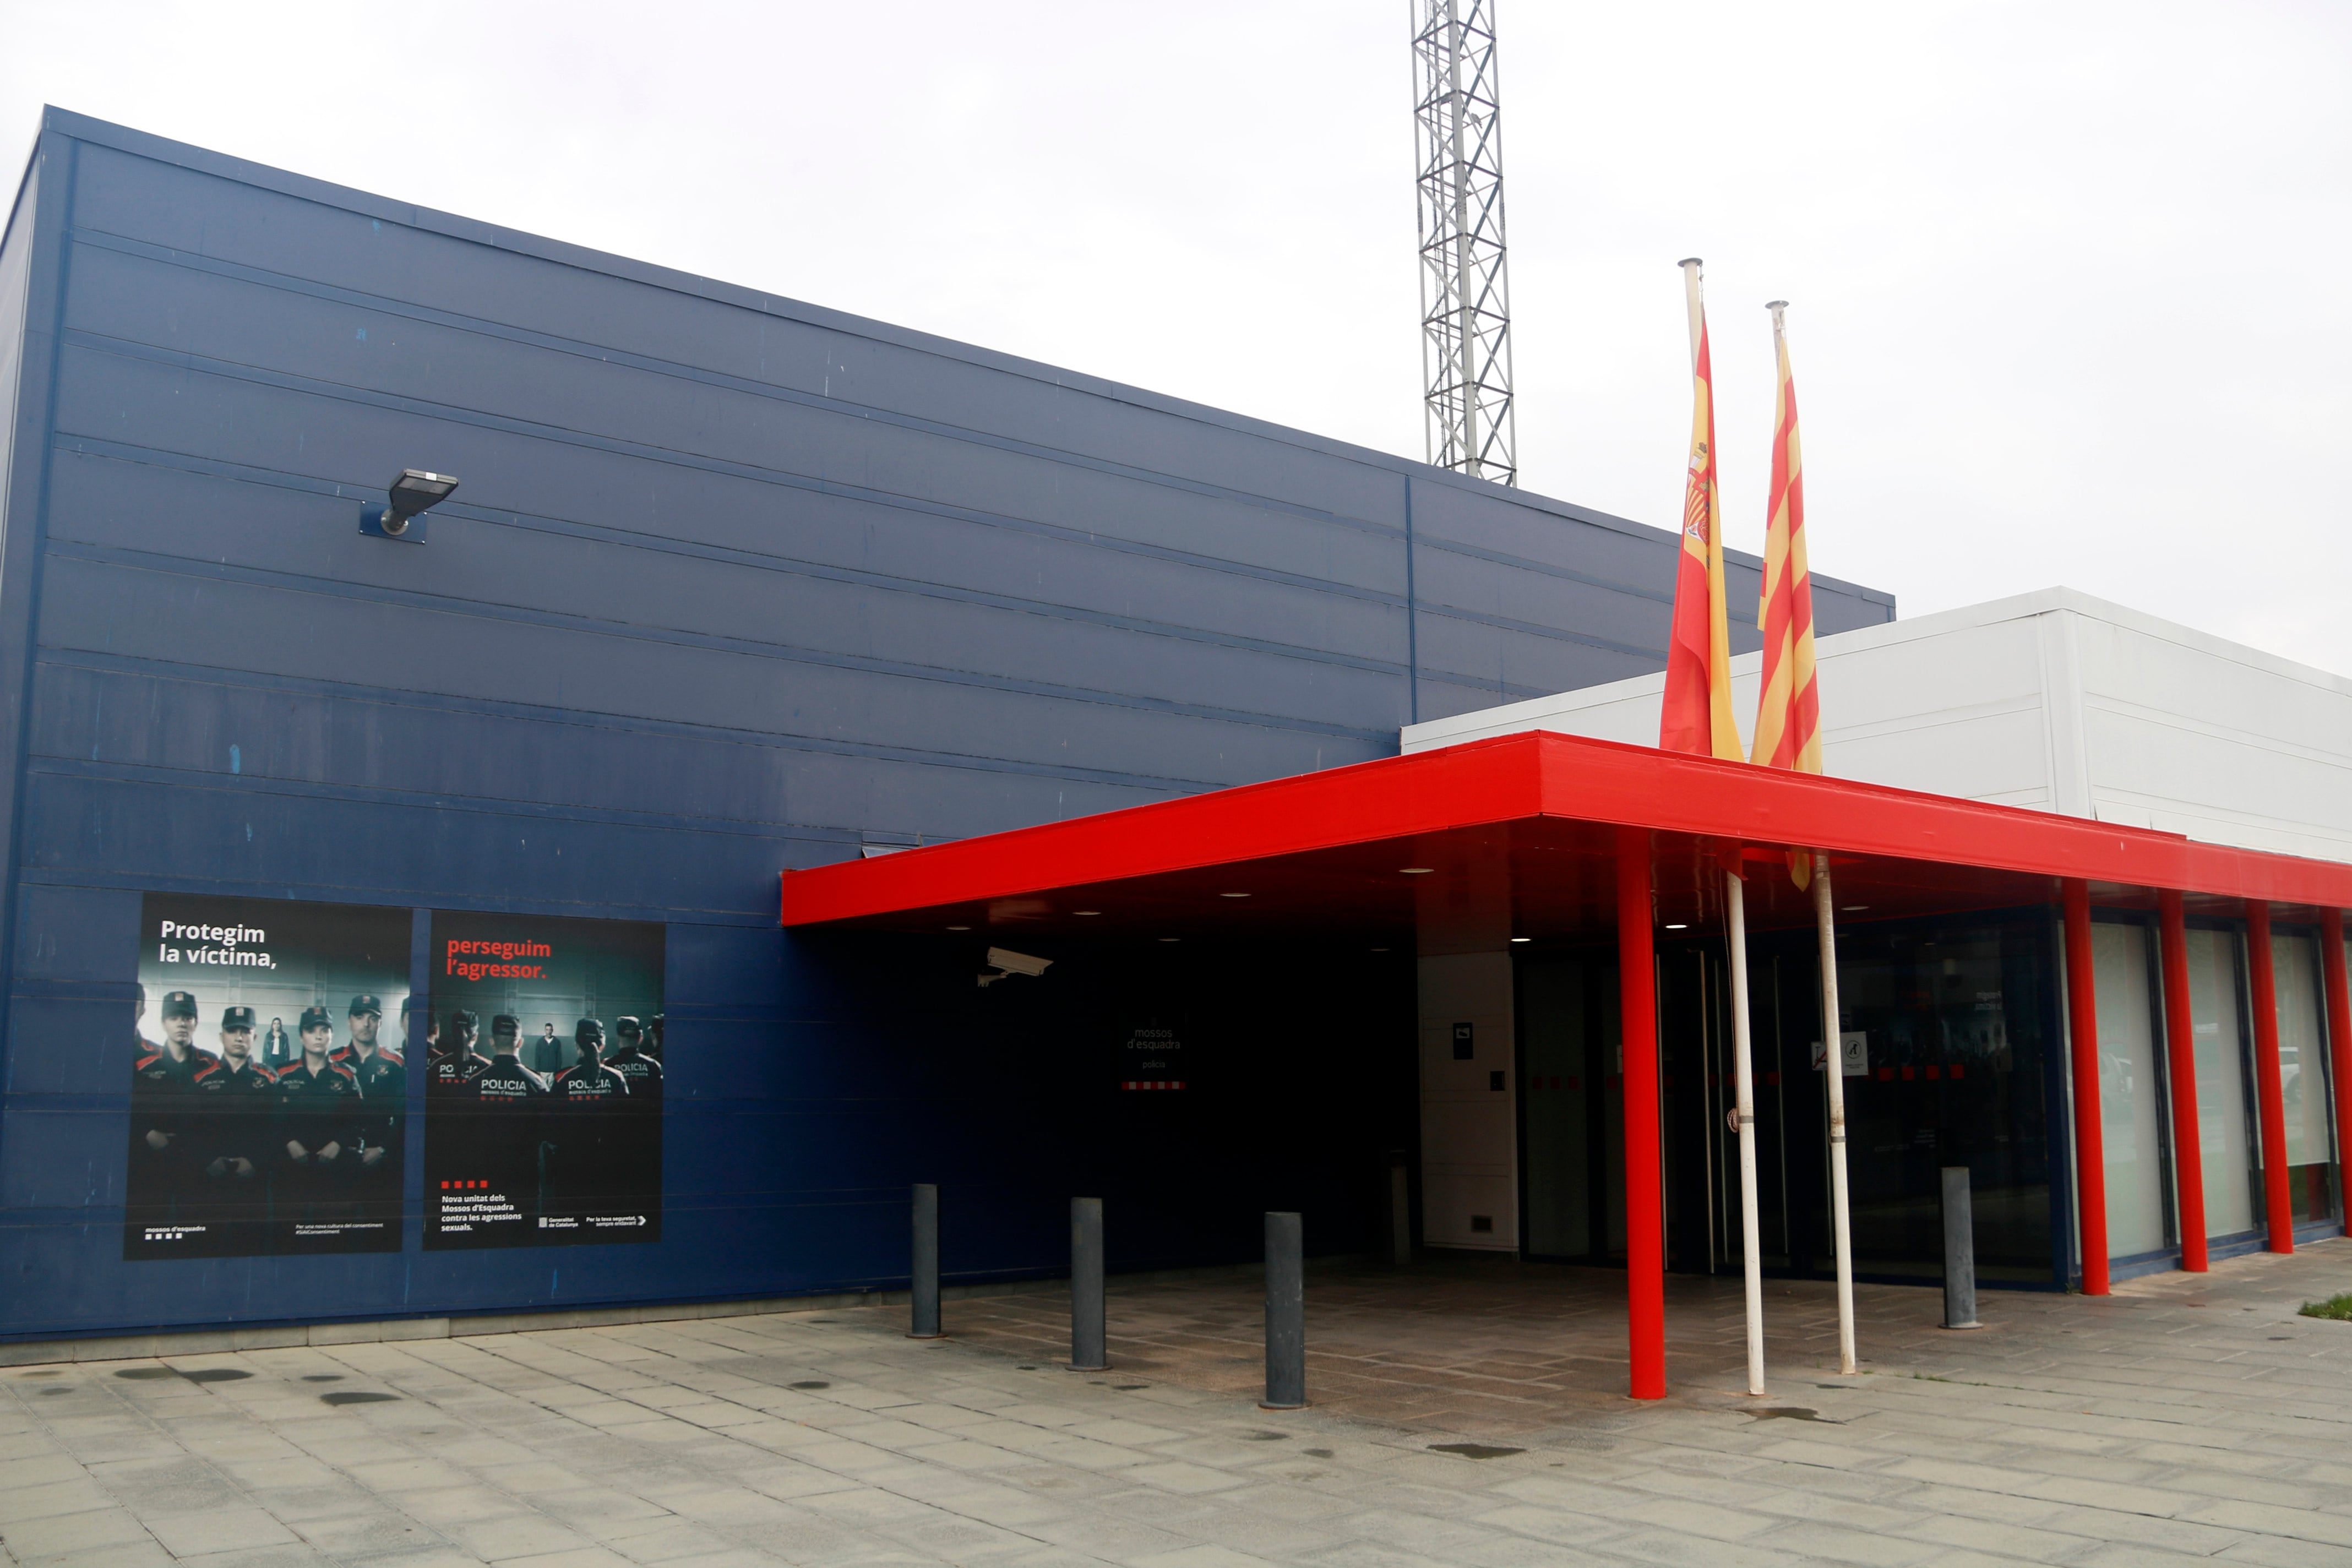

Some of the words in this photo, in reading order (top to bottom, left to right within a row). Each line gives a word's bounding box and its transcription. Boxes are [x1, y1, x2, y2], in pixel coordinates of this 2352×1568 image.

[161, 920, 265, 946] Protegim
[447, 939, 551, 960] perseguim
[160, 943, 179, 963] la
[186, 945, 276, 970] víctima,
[447, 958, 547, 981] l'agressor.
[1135, 1029, 1173, 1038] mossos
[1127, 1038, 1180, 1051] d'esquadra
[1142, 1059, 1166, 1069] policia
[481, 1079, 527, 1090] POLICIA
[568, 1079, 611, 1090] POLIA
[464, 1194, 488, 1202] unitat
[472, 1204, 514, 1212] d'Esquadra
[481, 1213, 522, 1222] agressions
[440, 1223, 473, 1232] sexuals.
